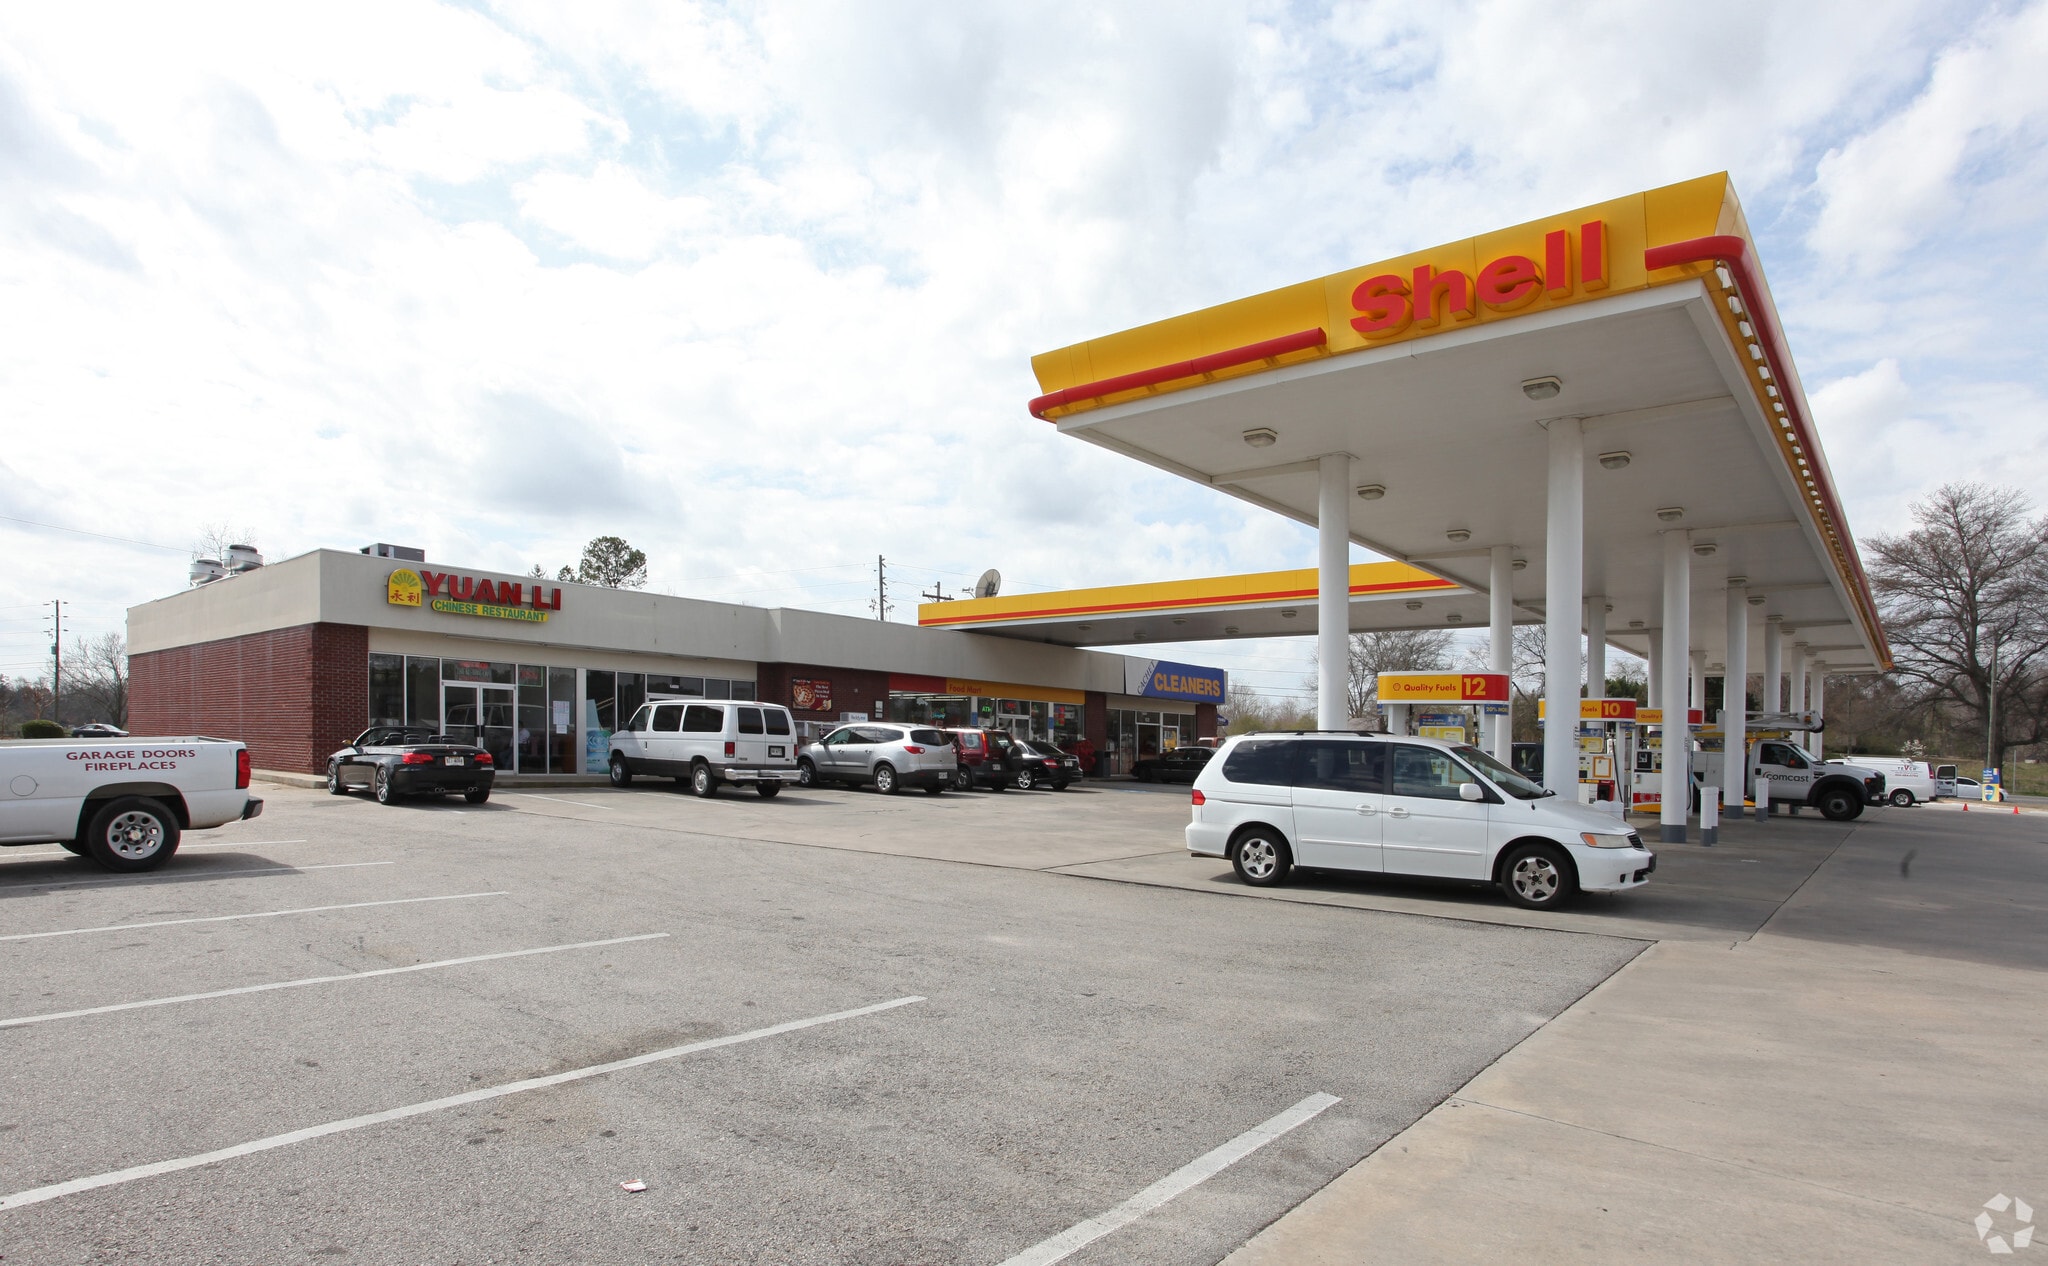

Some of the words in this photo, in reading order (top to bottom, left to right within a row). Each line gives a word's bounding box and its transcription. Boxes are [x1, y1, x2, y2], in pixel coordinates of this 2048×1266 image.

[1350, 220, 1606, 338] Shell
[420, 570, 521, 606] YUAN
[531, 585, 561, 611] LI
[434, 600, 478, 615] CHINESE
[482, 605, 545, 622] RESTAURANT
[1137, 660, 1156, 695] CACHET
[1154, 672, 1221, 697] CLEANERS
[949, 684, 965, 693] Food
[967, 686, 982, 694] Mart
[1403, 683, 1434, 693] Quality
[1436, 683, 1457, 692] Fuels
[1463, 677, 1486, 696] 12
[1603, 702, 1621, 716] 10
[66, 750, 135, 761] GARAGE
[142, 749, 196, 759] DOORS
[85, 761, 177, 771] FIREPLACES
[1763, 772, 1809, 782] comcast
